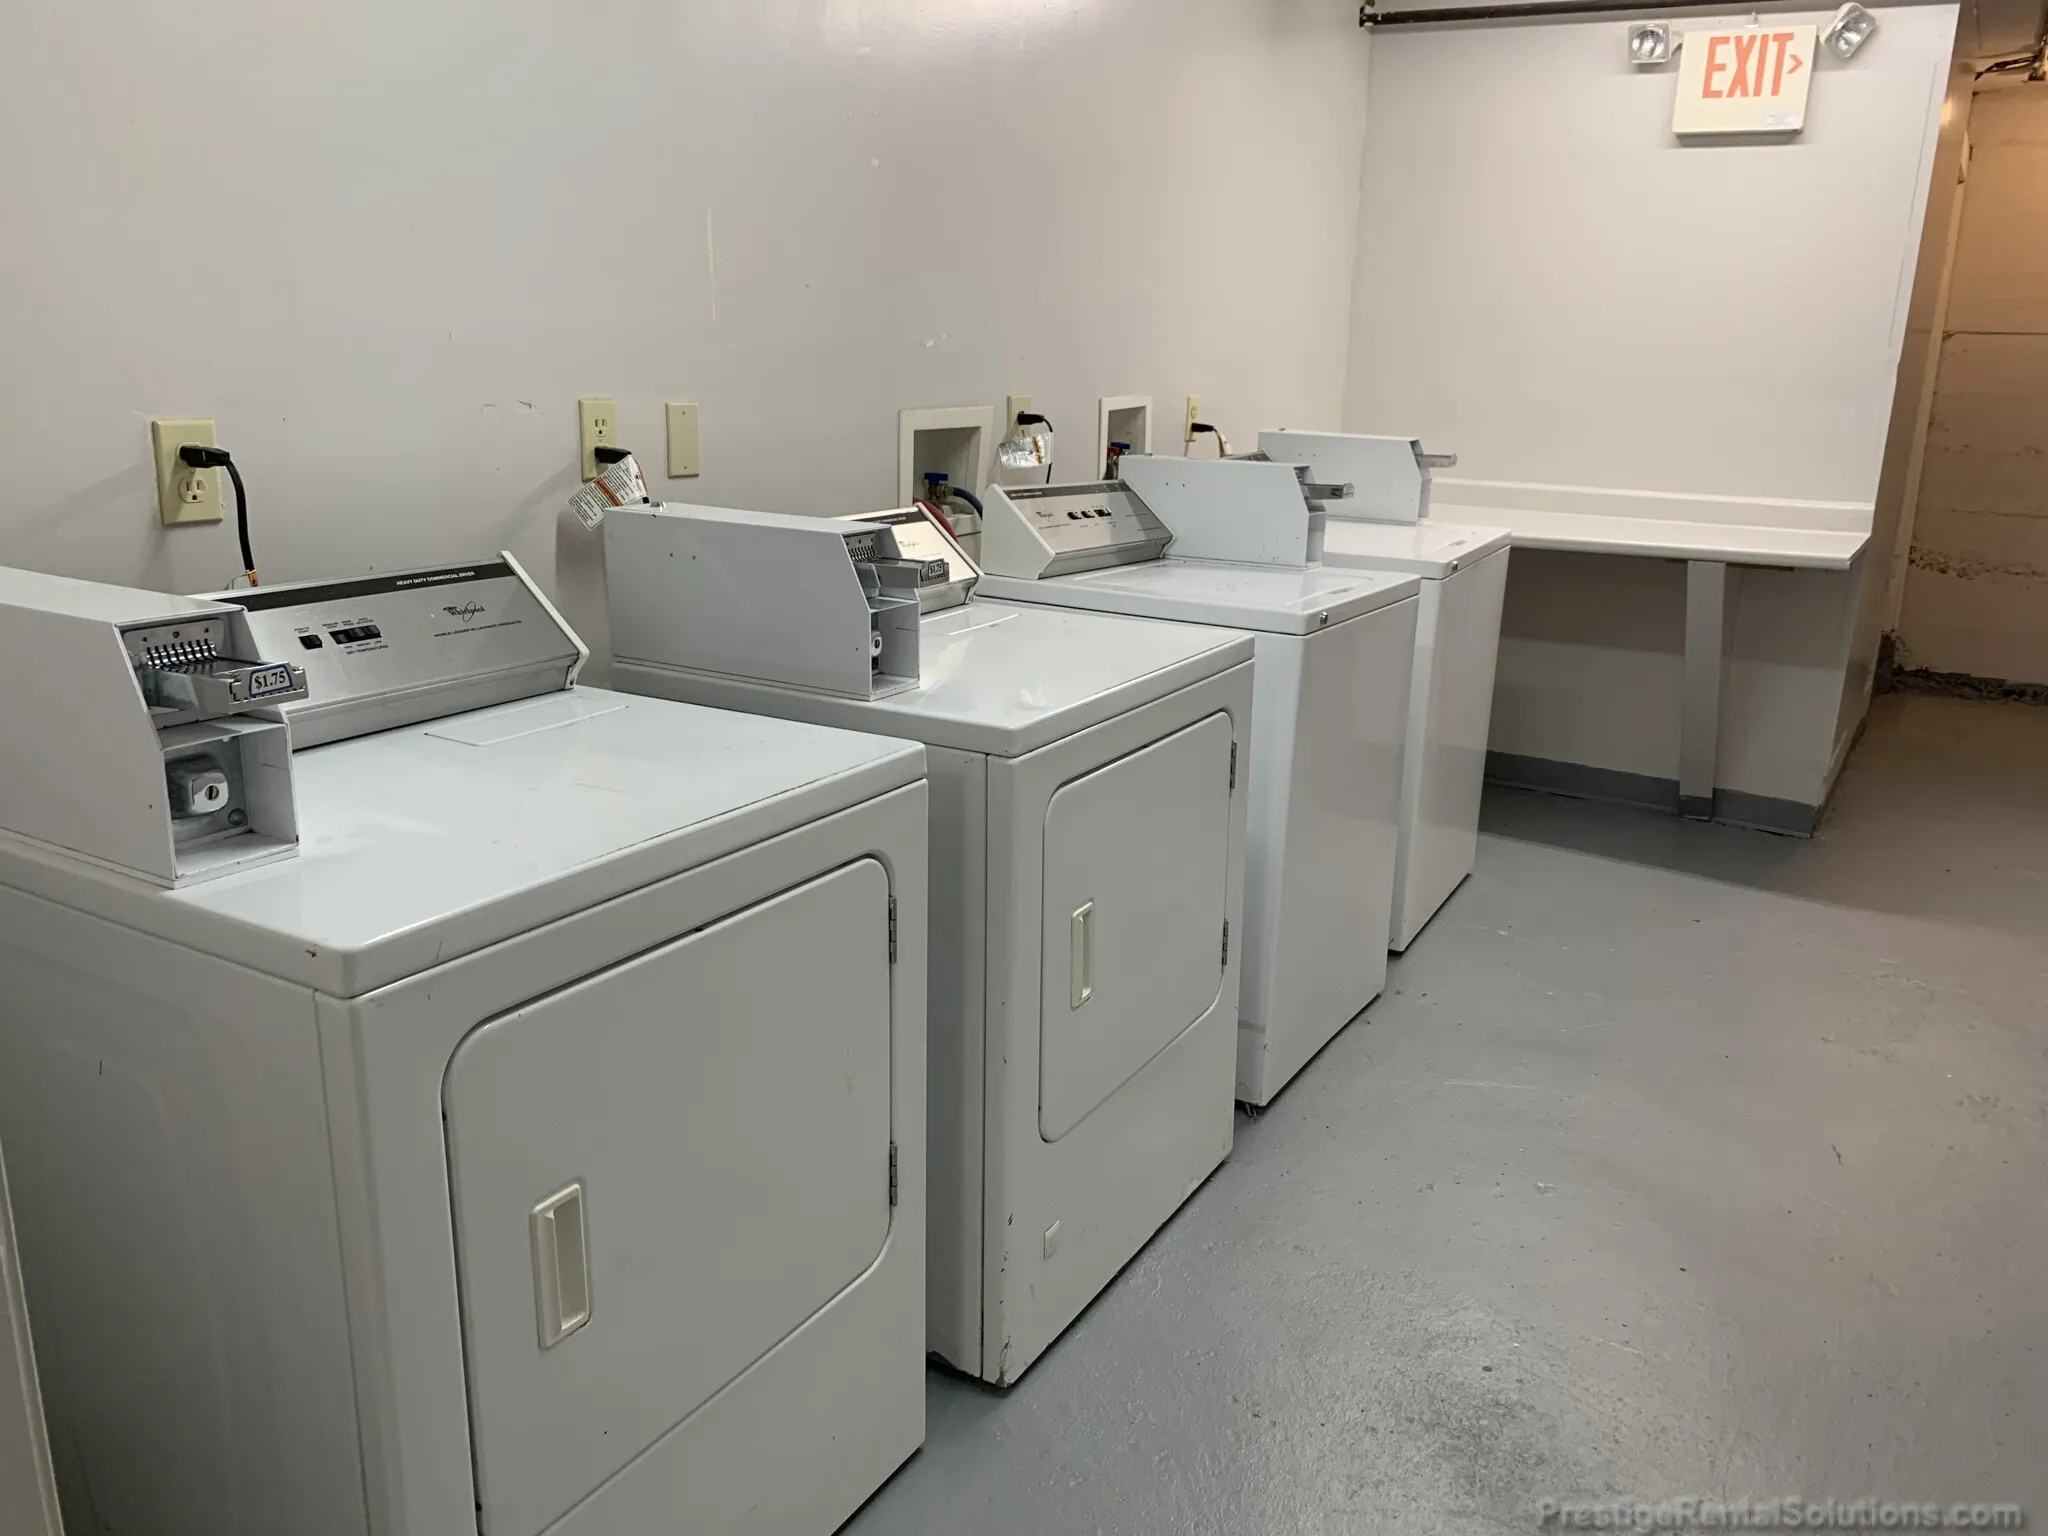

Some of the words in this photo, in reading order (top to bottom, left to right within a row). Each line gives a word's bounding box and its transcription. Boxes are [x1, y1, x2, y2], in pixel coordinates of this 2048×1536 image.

[1702, 33, 1795, 99] EXIT
[396, 578, 413, 586] HEAVY
[413, 576, 427, 584] DUTY
[427, 572, 459, 582] COMMERCIAL
[930, 564, 943, 575] $1.75
[443, 601, 486, 622] Whirlpool
[254, 670, 286, 690] $1.75
